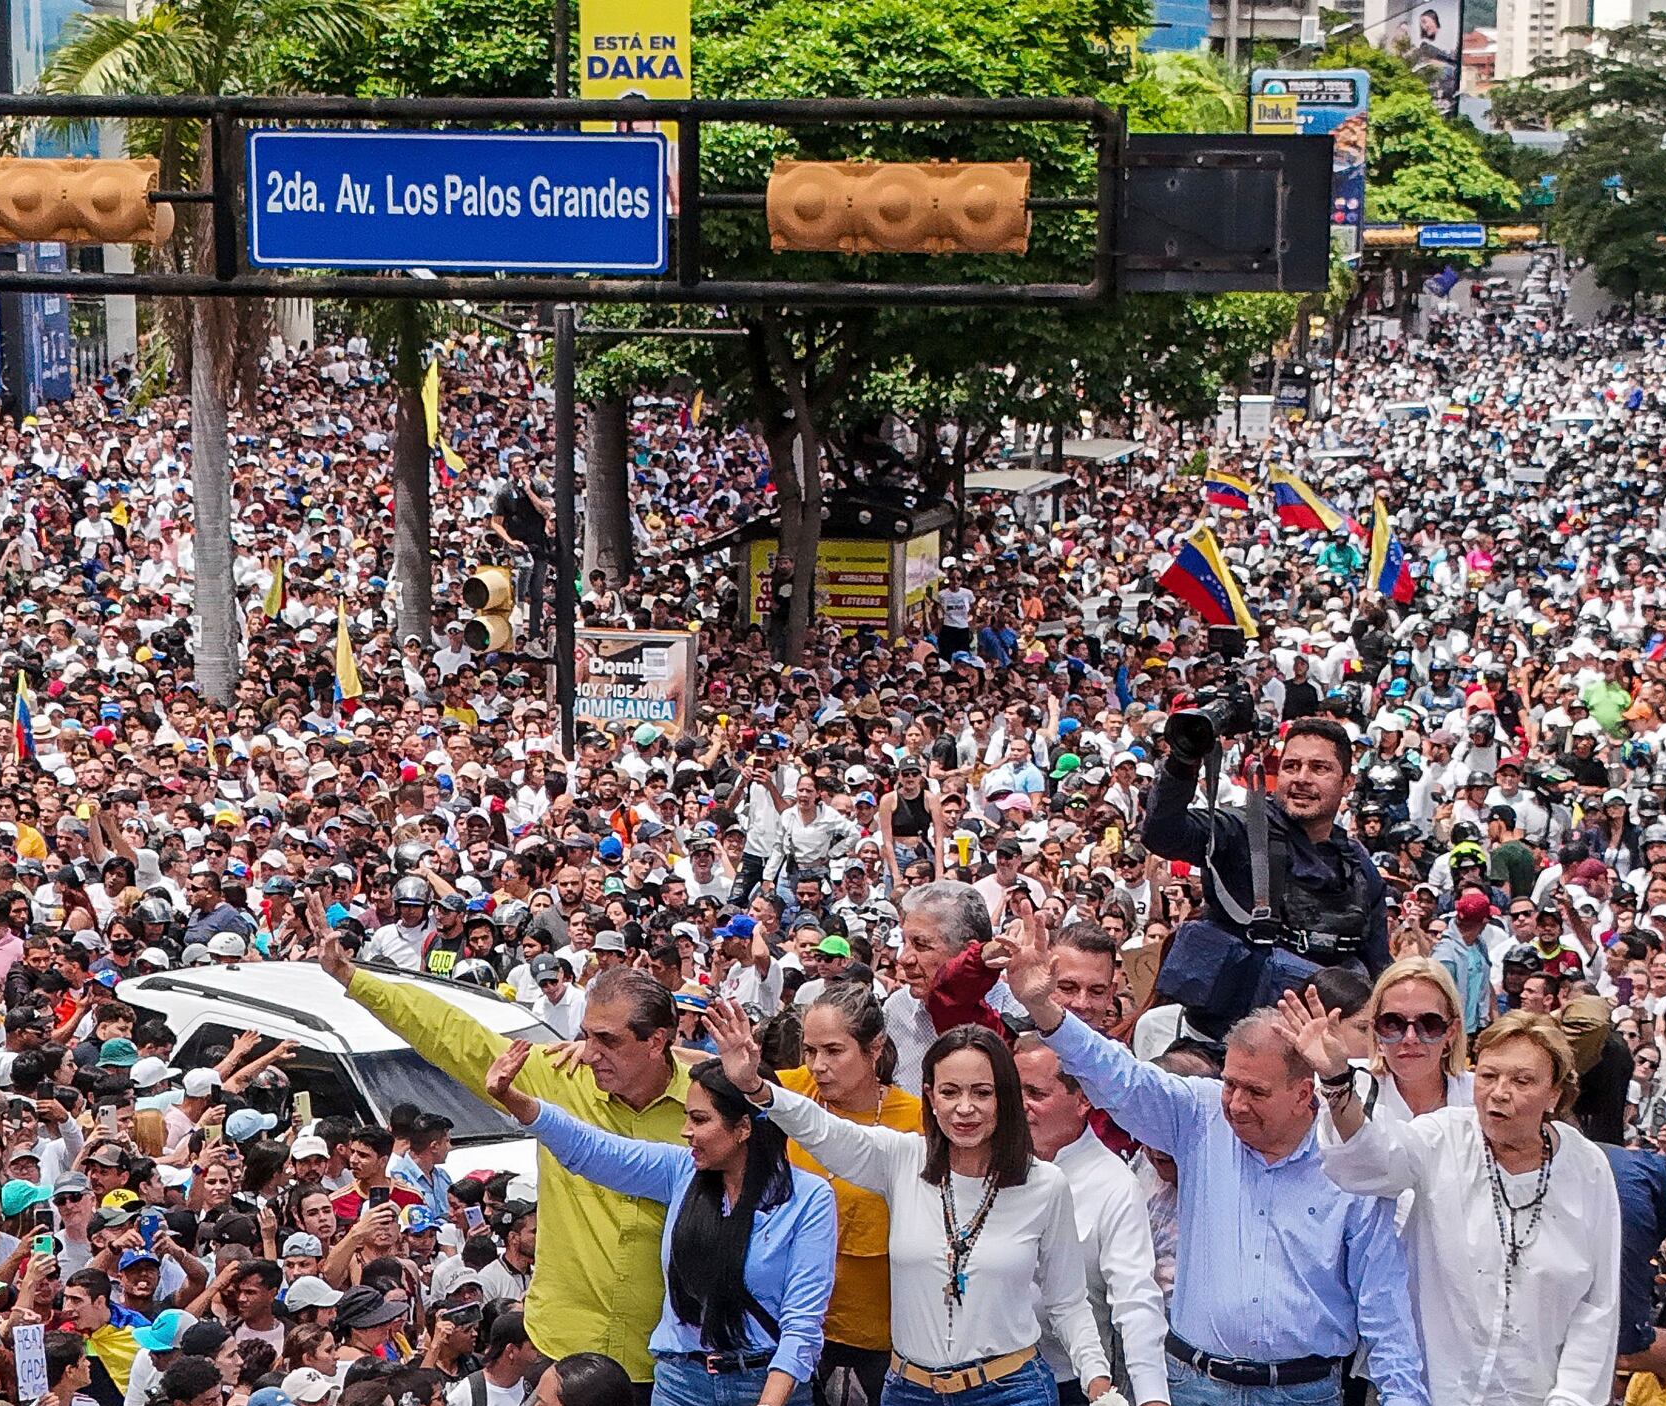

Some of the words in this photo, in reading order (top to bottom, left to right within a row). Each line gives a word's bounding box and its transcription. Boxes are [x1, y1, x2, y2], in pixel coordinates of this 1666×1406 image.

[593, 32, 643, 50] ESTÁ
[649, 36, 676, 50] EN
[587, 56, 685, 80] DAKA
[266, 170, 325, 214] 2da.
[335, 173, 375, 215] Av.
[386, 174, 439, 217] Los
[444, 174, 522, 218] Palos
[529, 175, 651, 219] Grandes
[588, 657, 645, 675] Domi
[603, 683, 635, 698] PIDE
[638, 683, 667, 700] UNA
